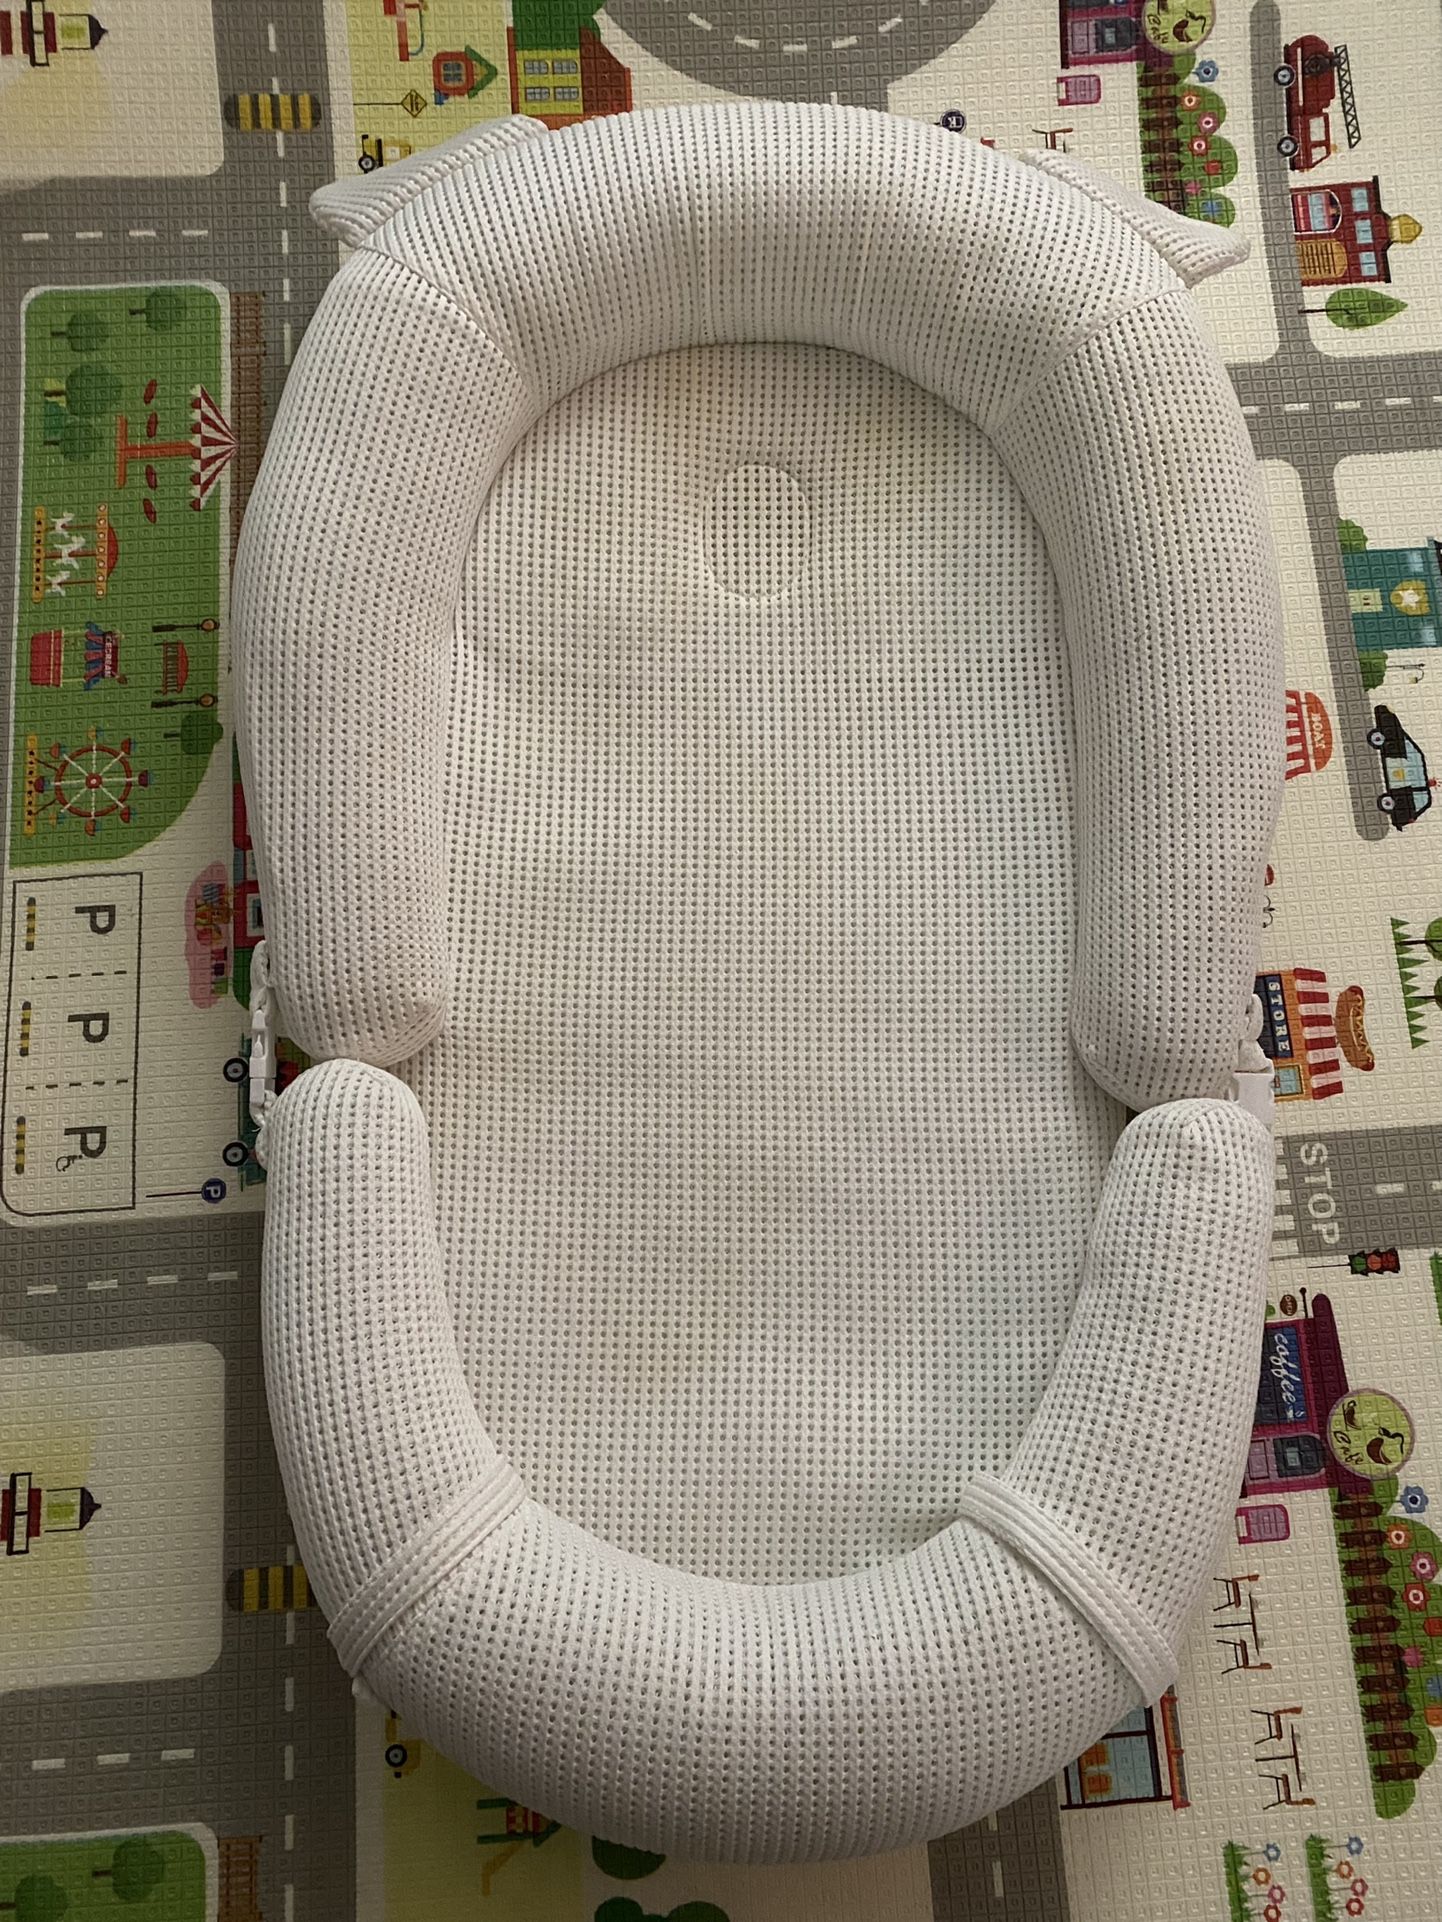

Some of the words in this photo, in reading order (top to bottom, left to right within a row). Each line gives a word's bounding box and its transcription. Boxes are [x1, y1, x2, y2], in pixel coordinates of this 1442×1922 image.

[1311, 712, 1326, 749] BOAT
[75, 904, 116, 935] P
[67, 1012, 110, 1044] P
[1268, 982, 1291, 1052] STORE
[64, 1125, 107, 1159] P
[205, 1185, 221, 1199] P
[1300, 1142, 1340, 1244] STOP
[1269, 1333, 1301, 1404] coffee
[1334, 1431, 1364, 1465] Cafe
